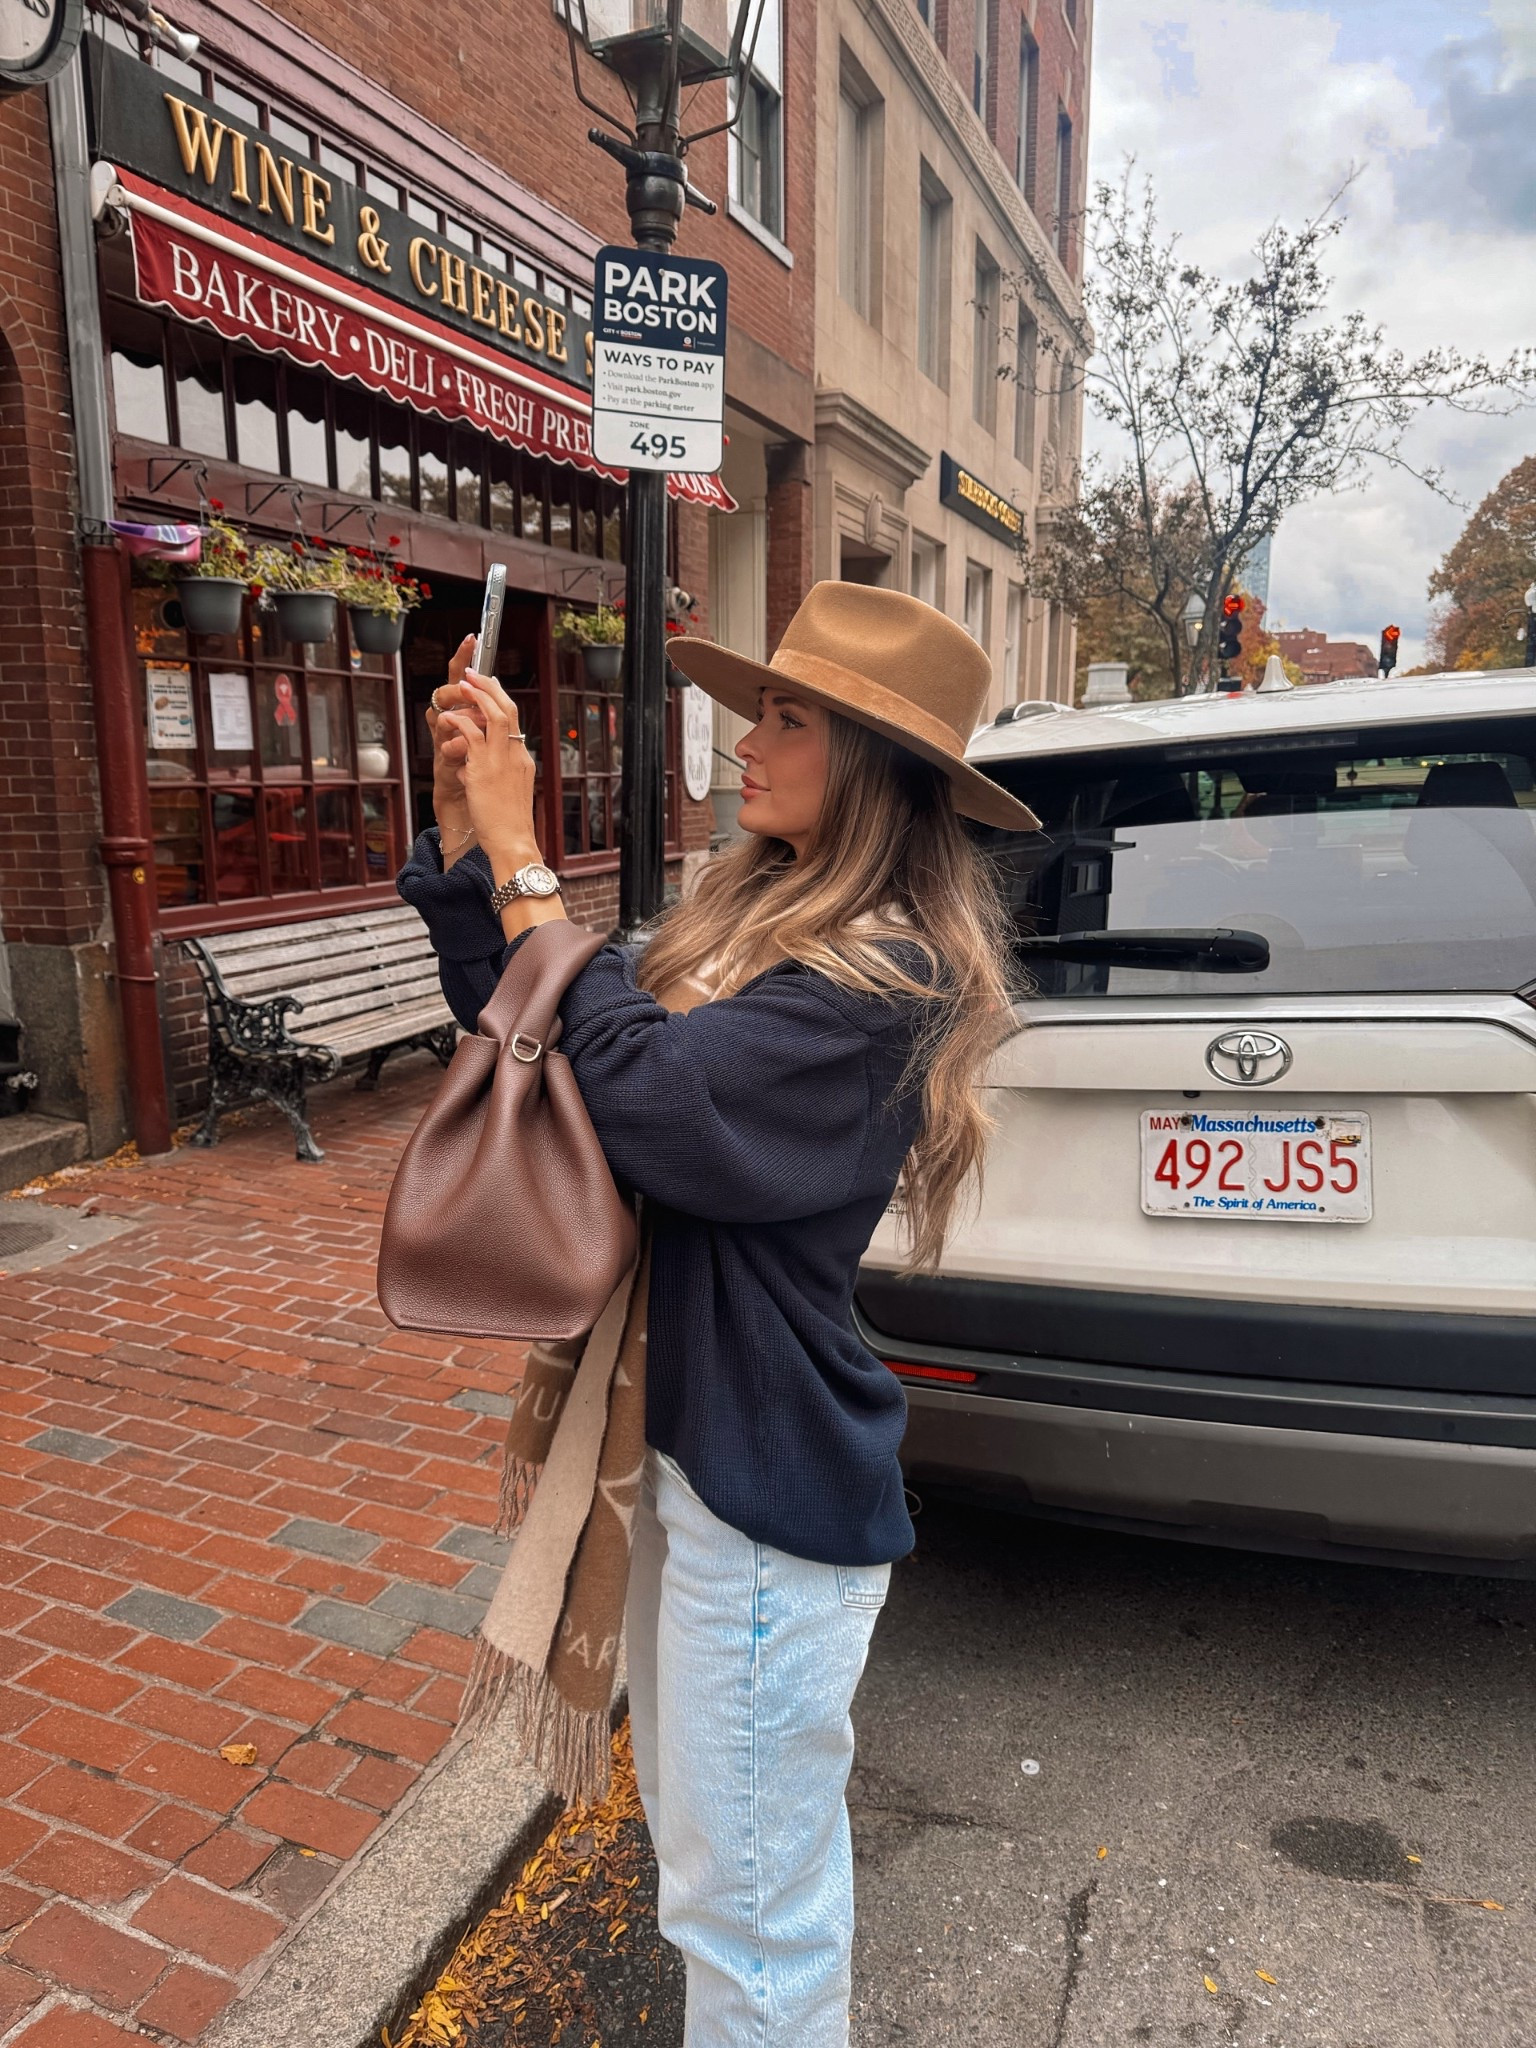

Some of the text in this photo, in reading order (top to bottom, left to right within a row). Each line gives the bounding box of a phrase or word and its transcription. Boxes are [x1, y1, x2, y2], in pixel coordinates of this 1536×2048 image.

[163, 92, 568, 364] WINE & CHEESE
[604, 260, 717, 309] PARK
[603, 298, 717, 335] BOSTON
[168, 241, 344, 358] BAKERY
[364, 328, 438, 397] DELI
[453, 366, 535, 439] FRESH
[541, 406, 593, 458] PRE
[604, 349, 715, 375] WAYS TO PAY
[608, 369, 714, 391] Download the ParkBoston app
[608, 382, 681, 399] Visit park.boston.gov
[607, 395, 695, 412] Pay at the parking meter
[629, 420, 650, 430] ZONE
[630, 432, 687, 459] 495
[1150, 1116, 1181, 1131] MAY
[1190, 1115, 1316, 1133] Massachusetts
[1154, 1138, 1358, 1194] 492 JS5
[1192, 1196, 1317, 1211] The Spirit of America
